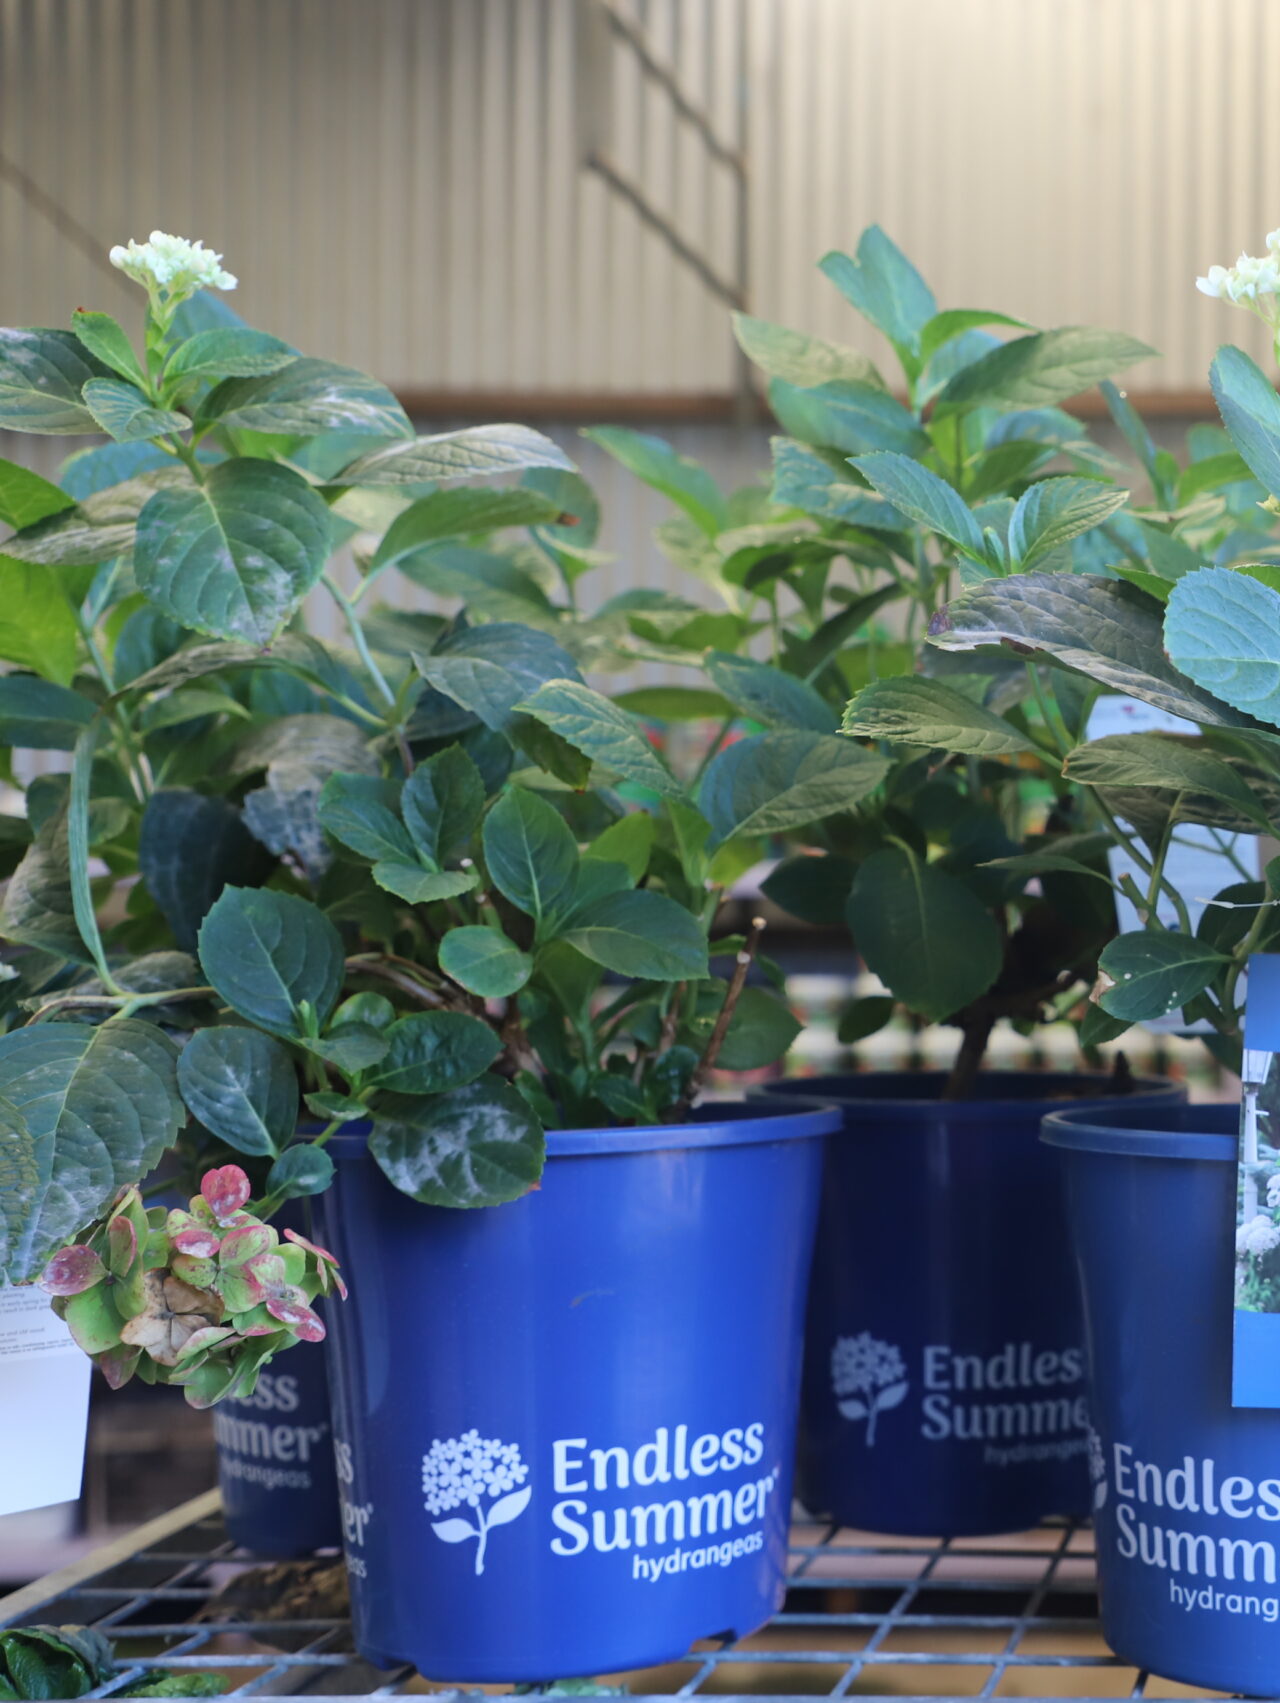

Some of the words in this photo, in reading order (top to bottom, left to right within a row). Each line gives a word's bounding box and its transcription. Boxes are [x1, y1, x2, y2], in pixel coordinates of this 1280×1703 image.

[923, 1341, 1084, 1391] Endles
[921, 1393, 1090, 1440] Summe
[552, 1422, 764, 1493] Endless
[632, 1530, 764, 1583] hydrangeas
